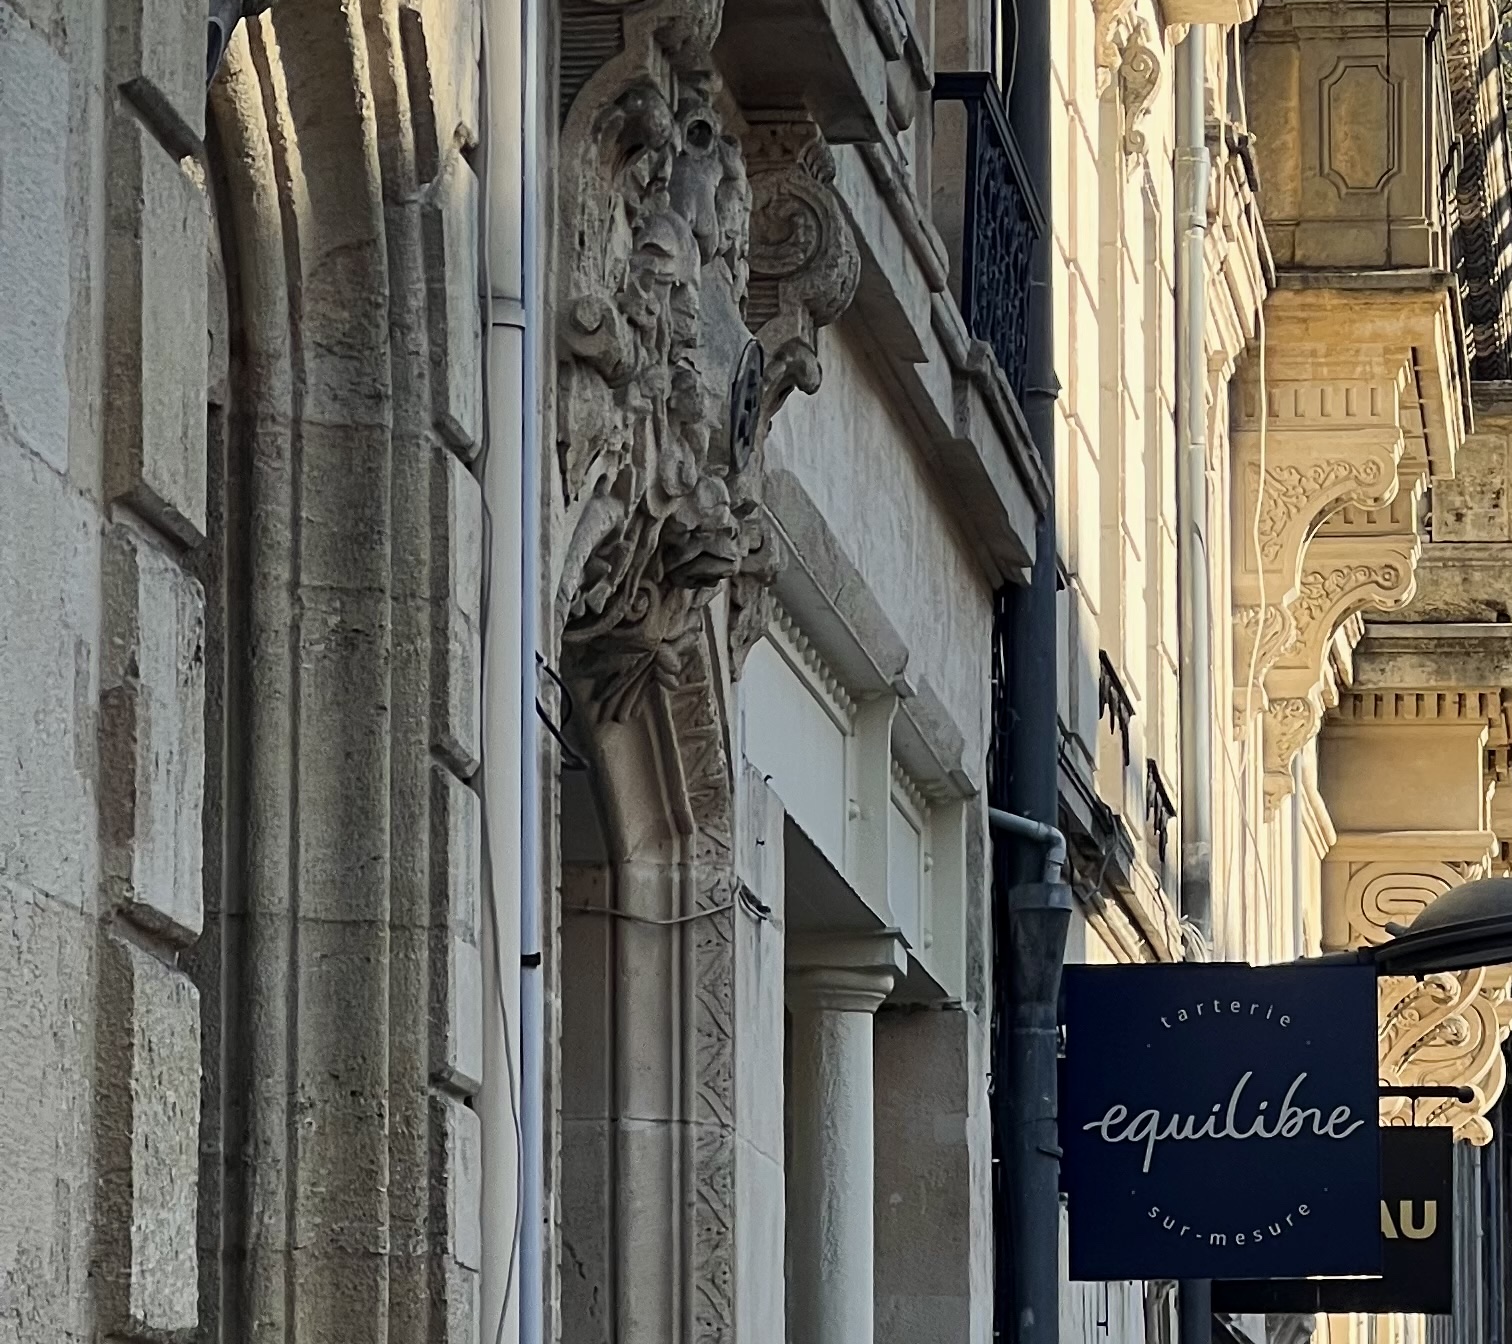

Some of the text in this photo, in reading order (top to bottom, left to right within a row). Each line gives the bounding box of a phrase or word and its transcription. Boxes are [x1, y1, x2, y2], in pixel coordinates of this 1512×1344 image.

[1160, 999, 1291, 1029] tarterie
[1083, 1071, 1365, 1173] equilibre
[1147, 1202, 1311, 1246] sur-mesure
